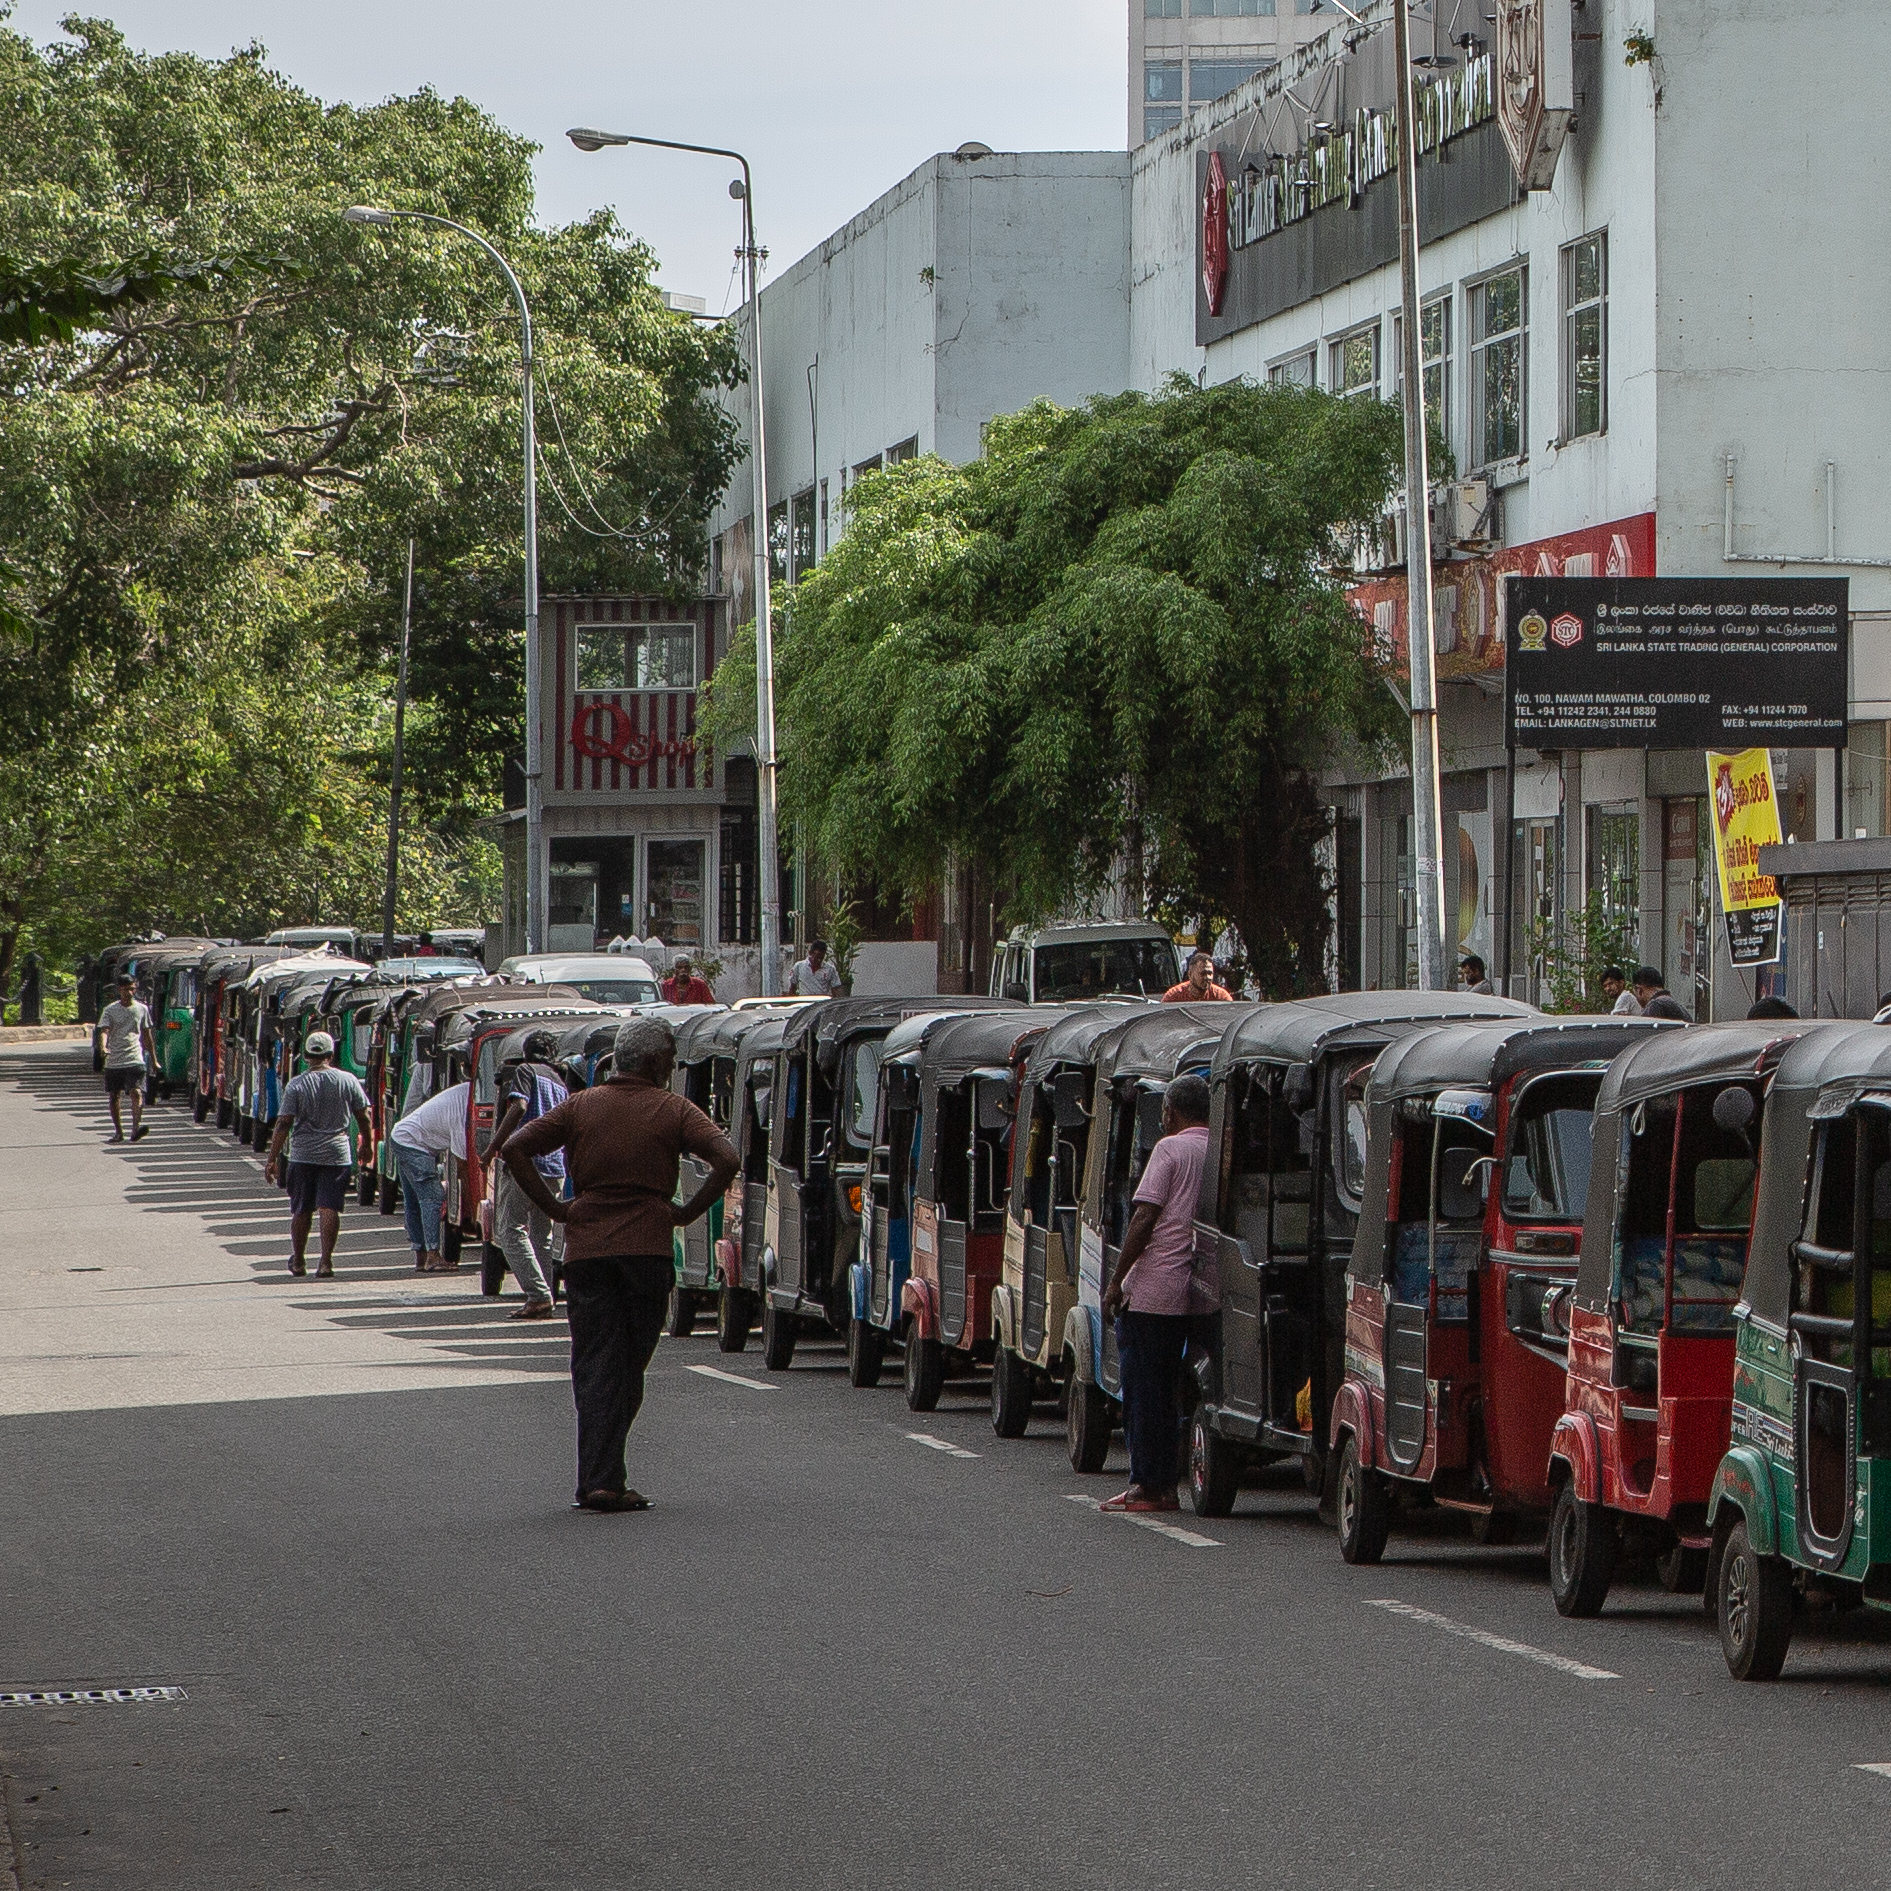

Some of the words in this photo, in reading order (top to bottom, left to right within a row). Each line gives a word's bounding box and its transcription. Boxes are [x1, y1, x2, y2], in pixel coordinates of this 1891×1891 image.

[1596, 642, 1612, 652] SRI
[1614, 642, 1645, 652] LANKA
[1647, 642, 1677, 652] STATE
[1678, 642, 1719, 652] TRADING
[1720, 642, 1770, 654] (GENERAL)
[1771, 642, 1838, 652] CORPORATION
[1515, 693, 1532, 703] NO.
[1555, 693, 1594, 703] NAWAM
[1648, 693, 1697, 703] COLOMBO
[1698, 693, 1710, 703] 02
[1537, 706, 1555, 716] +94
[1557, 706, 1585, 716] 11242
[1614, 706, 1631, 716] 244
[1722, 705, 1742, 715] FAX:
[1743, 705, 1759, 715] +94
[1762, 705, 1786, 715] 11244
[1788, 705, 1808, 715] 7970
[1514, 718, 1547, 728] EMAIL:
[1548, 718, 1657, 730] LANKAGEN@SLTNET.LK
[1722, 718, 1748, 728] WEB:
[568, 702, 648, 767] Q
